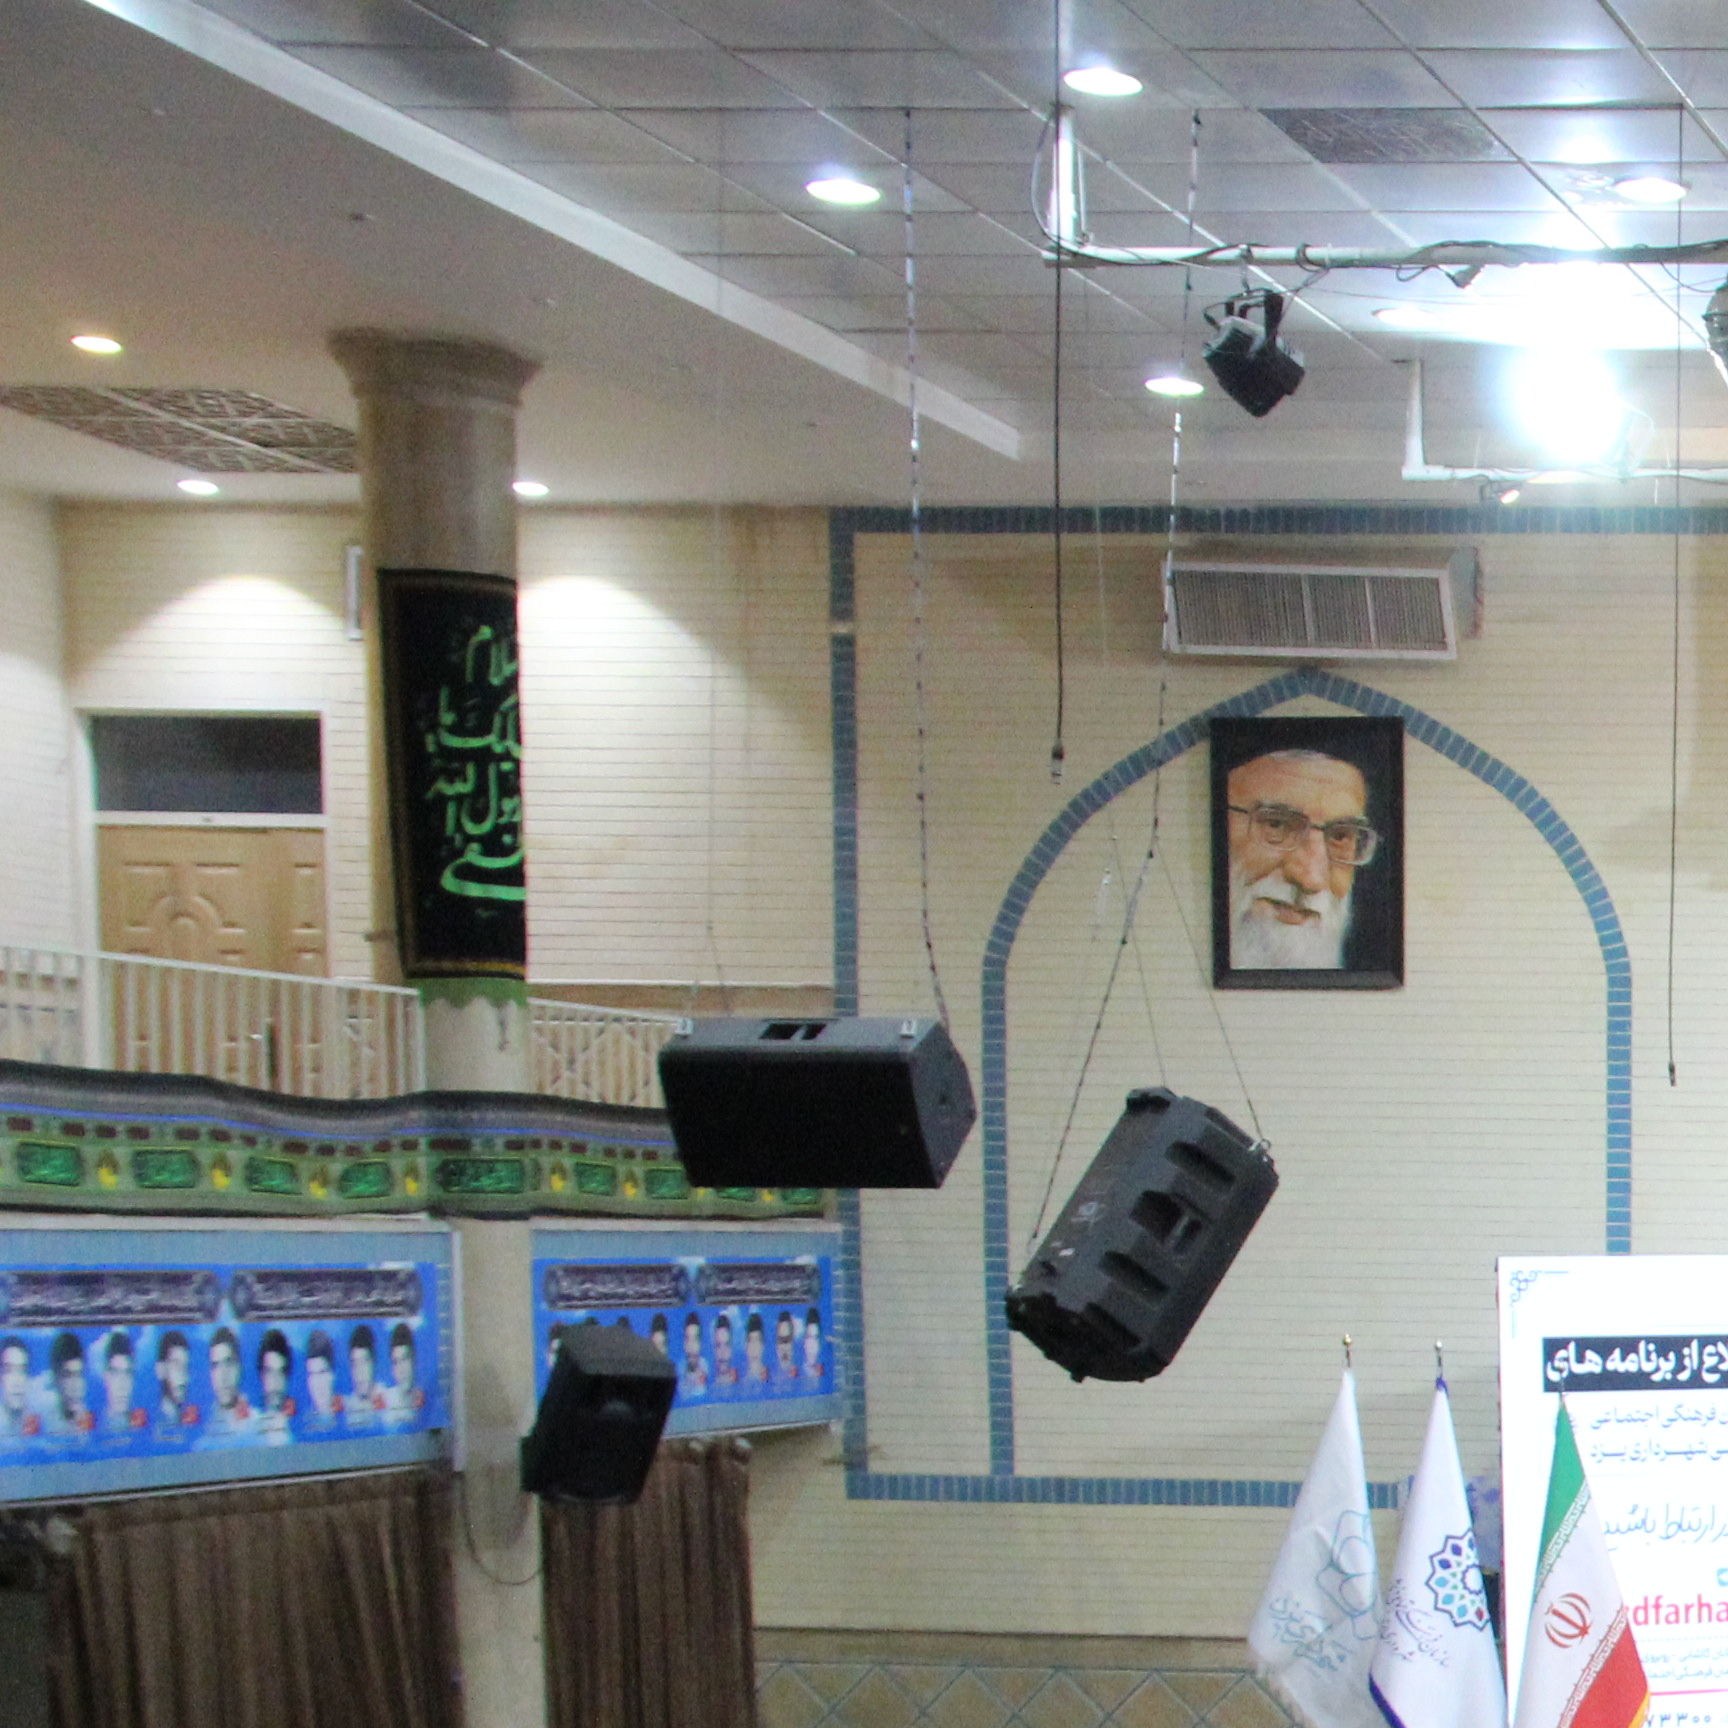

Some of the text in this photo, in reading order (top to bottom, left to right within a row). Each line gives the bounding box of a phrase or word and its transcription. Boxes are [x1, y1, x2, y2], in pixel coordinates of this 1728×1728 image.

[1546, 1340, 1604, 1383] های
[1605, 1340, 1676, 1382] برنامه
[1676, 1338, 1700, 1382] از
